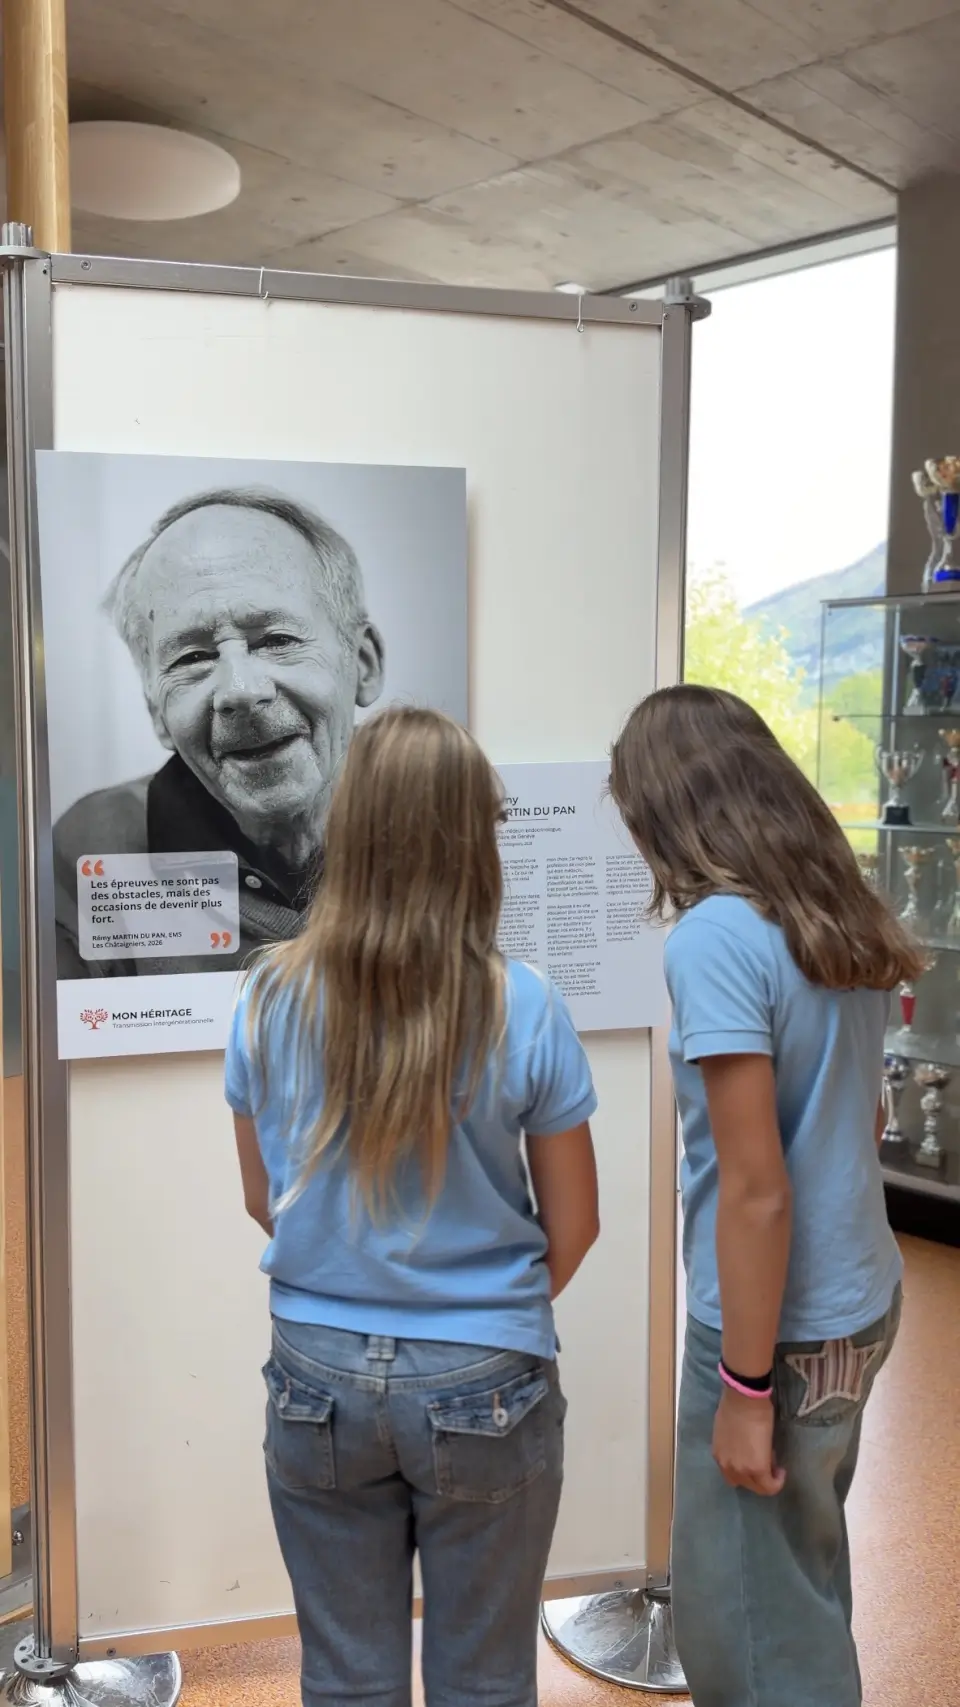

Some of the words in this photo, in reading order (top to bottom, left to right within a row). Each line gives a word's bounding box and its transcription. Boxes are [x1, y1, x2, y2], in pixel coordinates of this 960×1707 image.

[501, 796, 519, 806] my
[504, 807, 531, 817] RTIN
[533, 806, 550, 816] DU
[553, 805, 576, 815] PAN
[90, 880, 109, 889] Les
[110, 879, 159, 891] épreuves
[161, 879, 174, 887] ne
[176, 876, 200, 887] sont
[202, 876, 220, 886] pas
[91, 891, 109, 901] des
[111, 889, 164, 900] obstacles,
[166, 887, 191, 898] mais
[193, 887, 211, 897] des
[91, 902, 142, 912] occasions
[144, 900, 157, 910] de
[159, 899, 199, 910] devenir
[201, 899, 223, 909] plus
[91, 914, 115, 924] fort.
[92, 934, 111, 942] Rémy
[151, 931, 168, 939] PAN,
[104, 940, 146, 949] Châtaigniers,
[112, 1012, 138, 1021] MON
[140, 1008, 192, 1019] HÉRITAGE
